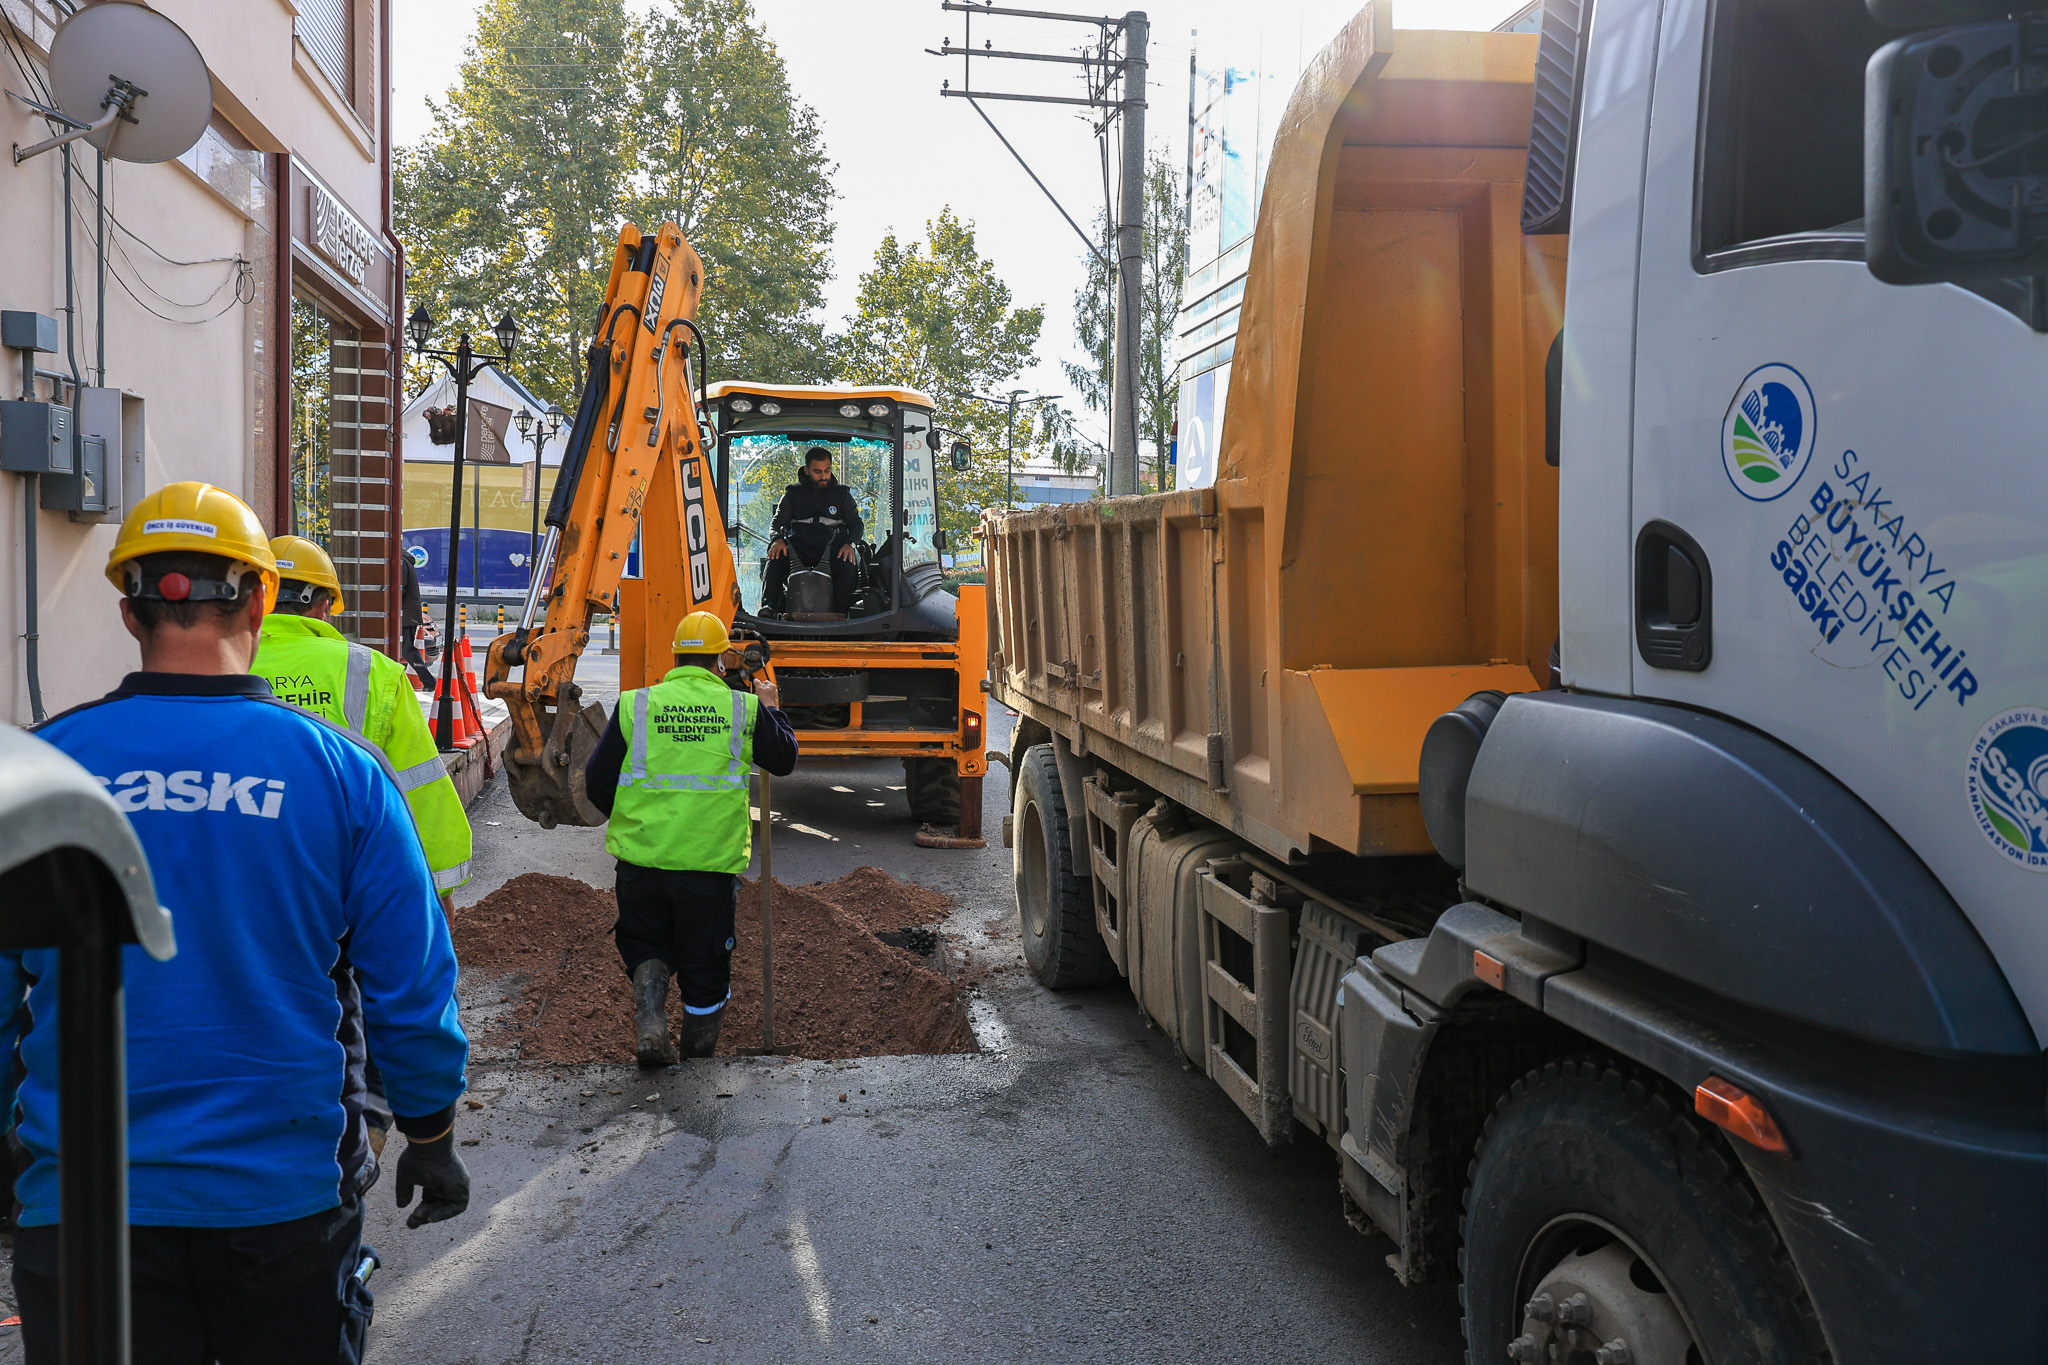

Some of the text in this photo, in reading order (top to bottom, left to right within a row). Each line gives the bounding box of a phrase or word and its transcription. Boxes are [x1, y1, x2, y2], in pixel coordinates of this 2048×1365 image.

[336, 208, 376, 266] pencere
[480, 404, 489, 443] pencre
[146, 521, 214, 534] ÖNCE İŞ GÜVENLİĞİ
[682, 463, 710, 600] JCB
[1834, 449, 1956, 615] SAKARYA
[1809, 481, 1979, 707] BÜYÜKŞEHİR
[1787, 513, 1938, 711] BELEDİYESİ
[279, 689, 332, 706] EHİR
[663, 705, 717, 714] SAKARYA
[654, 713, 726, 725] BÜYÜKŞEHİR
[657, 723, 721, 734] BELEDİYESİ
[1988, 713, 2038, 736] SAKARYA
[1975, 736, 1988, 753] SU
[1969, 756, 1979, 771] VE
[94, 770, 286, 819] aski
[1968, 776, 2024, 861] KANALİZASYON
